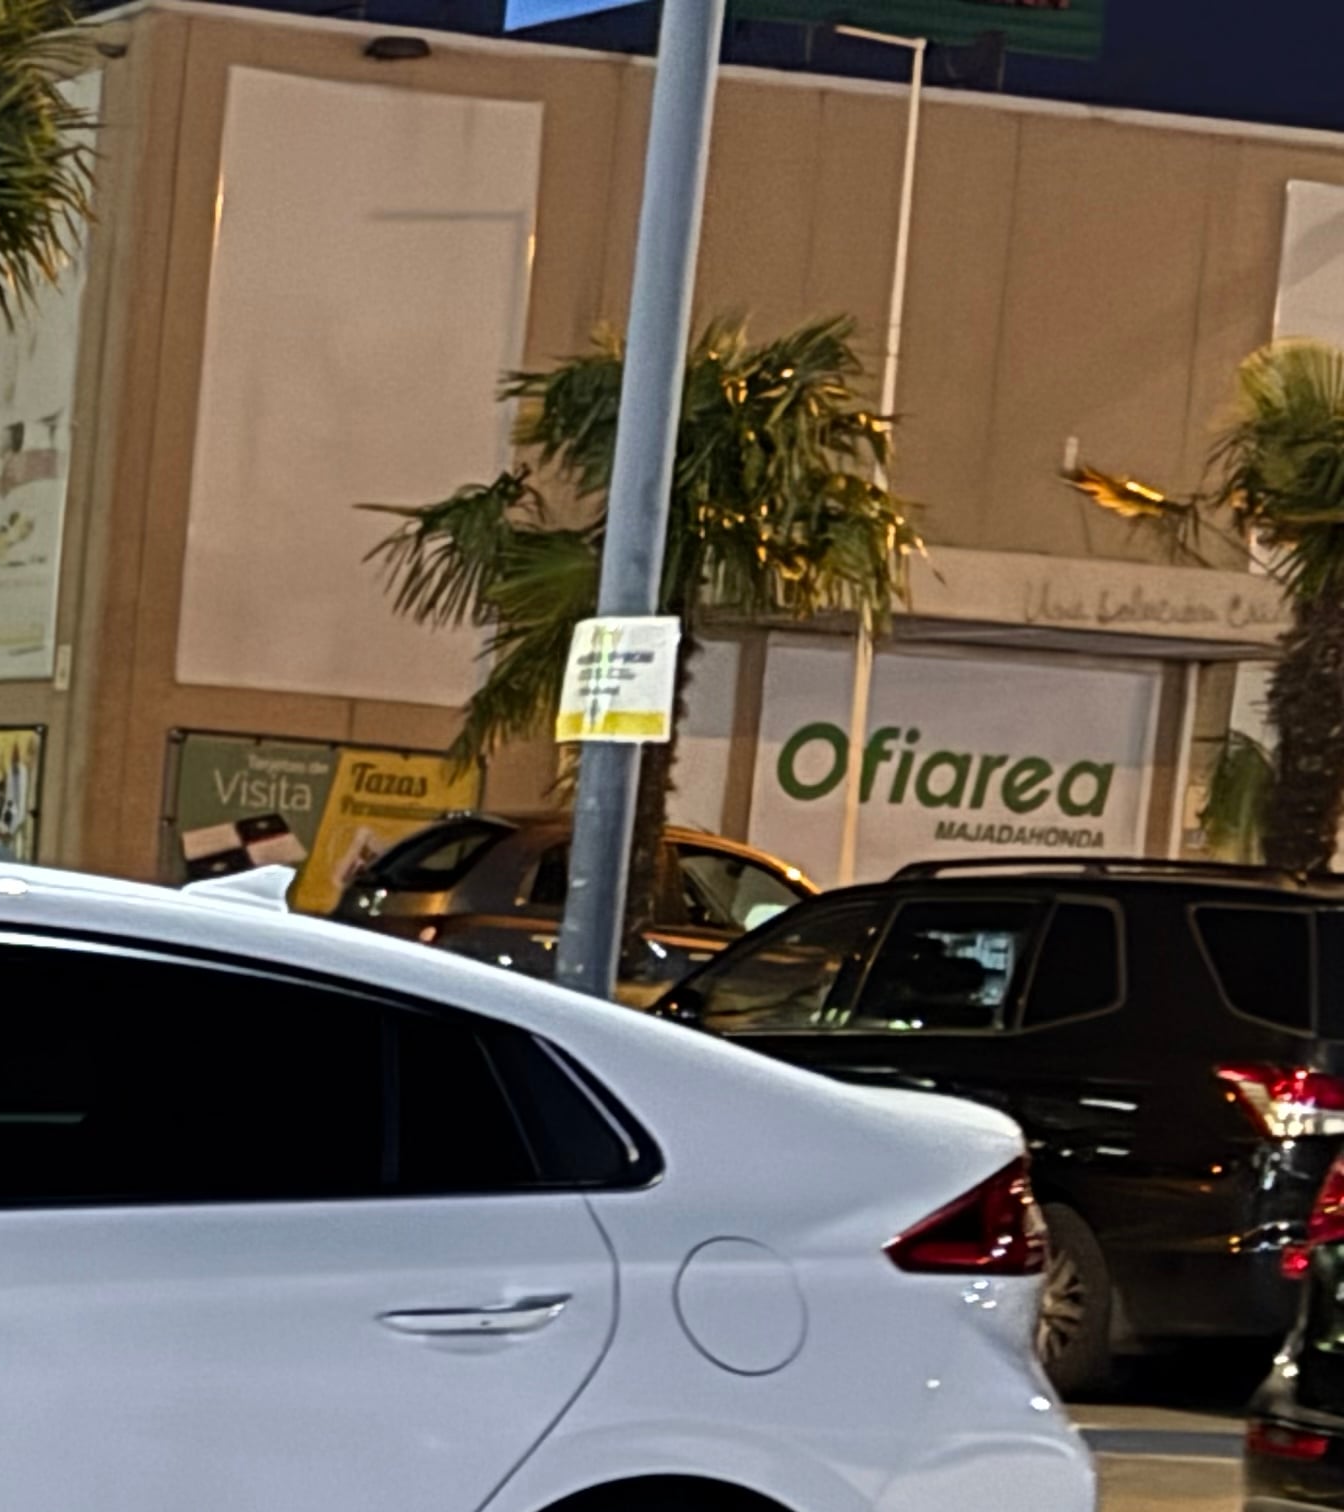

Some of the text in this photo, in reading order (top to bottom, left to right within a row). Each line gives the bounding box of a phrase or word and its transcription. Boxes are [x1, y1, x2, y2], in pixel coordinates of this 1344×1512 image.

[213, 767, 312, 812] Visita
[350, 761, 429, 798] Tazas
[776, 721, 1116, 818] Ofiarea
[933, 820, 1105, 850] MAJADAHONDA
